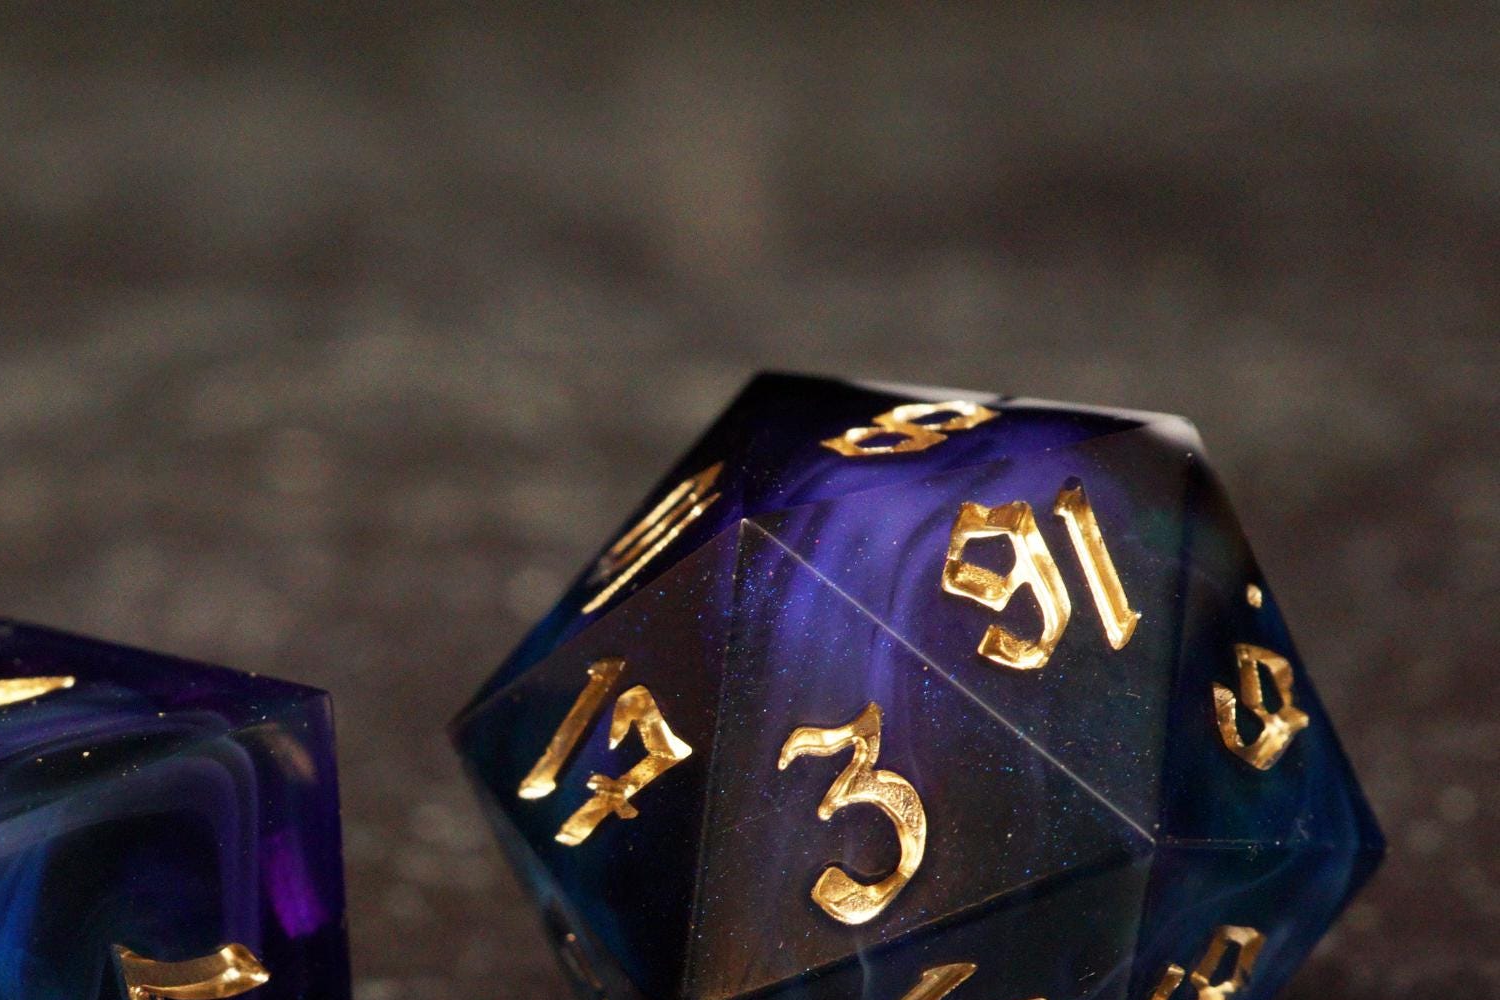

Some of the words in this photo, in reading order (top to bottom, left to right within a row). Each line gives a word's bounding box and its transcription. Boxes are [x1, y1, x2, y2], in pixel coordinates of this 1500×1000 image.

[819, 400, 1000, 457] 8
[518, 656, 694, 847] 17
[778, 701, 928, 926] 3
